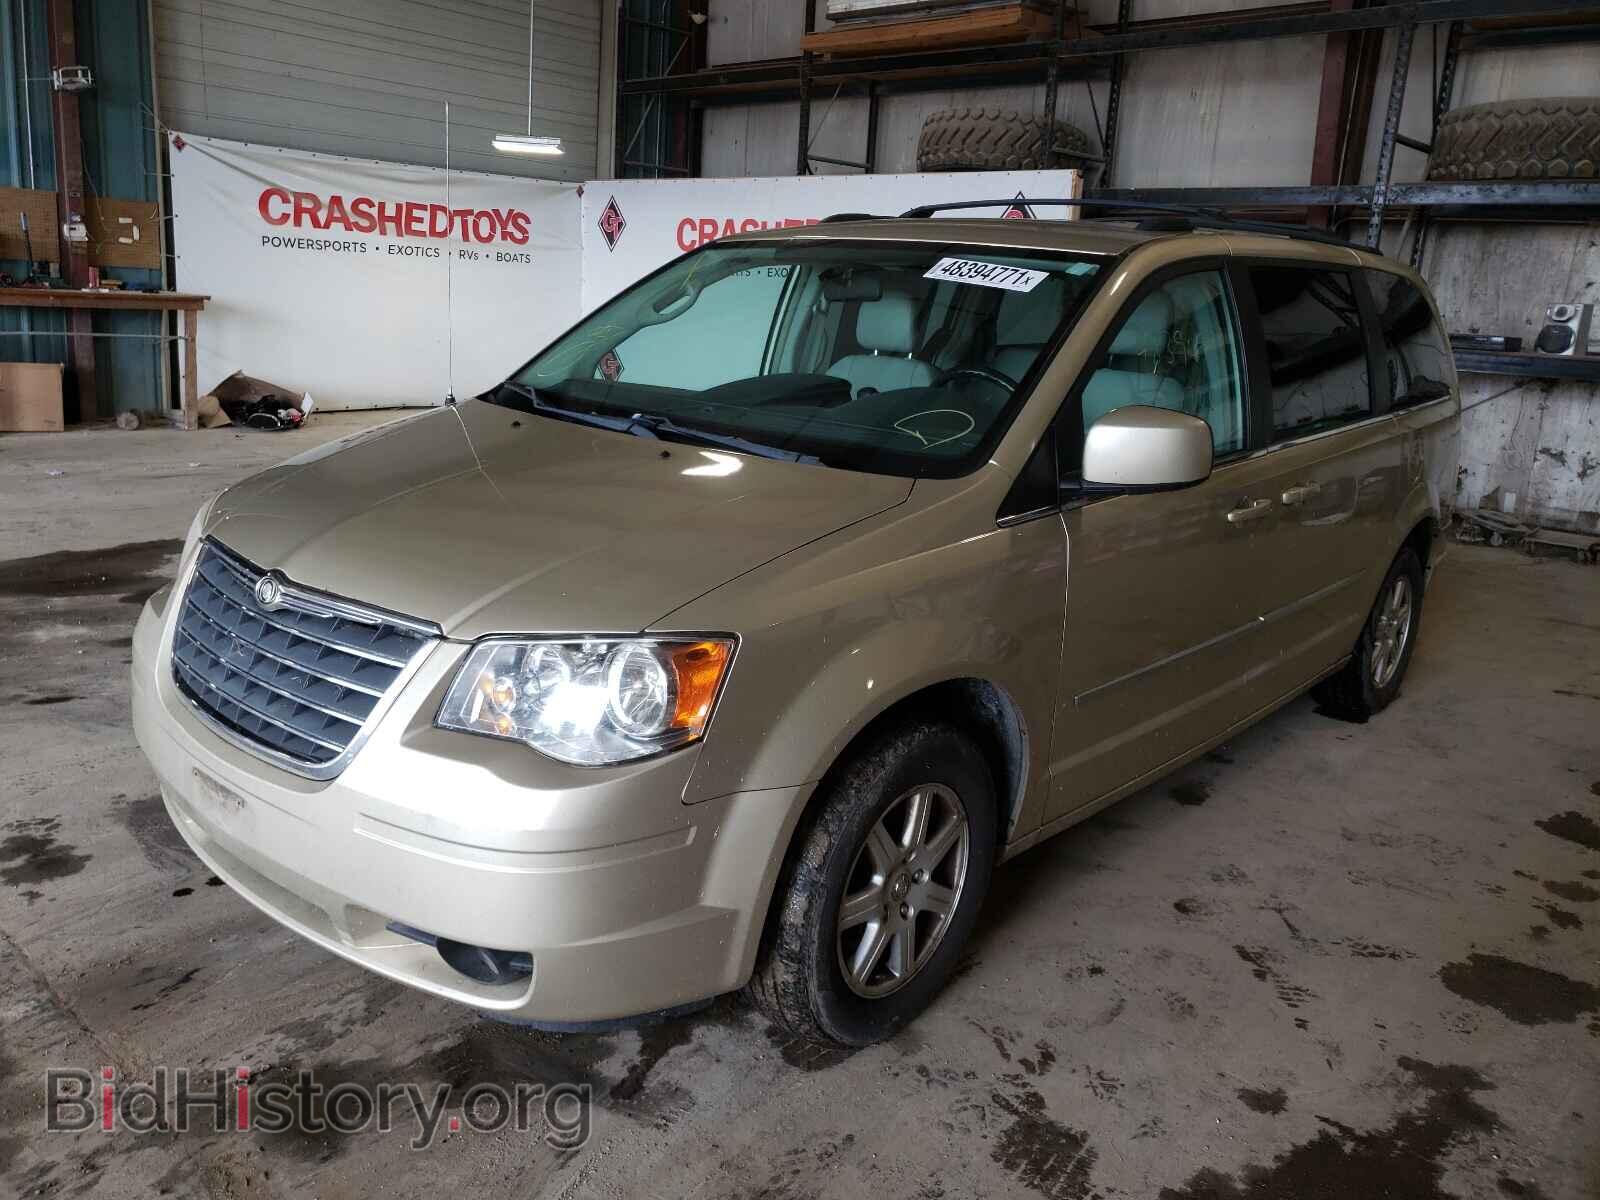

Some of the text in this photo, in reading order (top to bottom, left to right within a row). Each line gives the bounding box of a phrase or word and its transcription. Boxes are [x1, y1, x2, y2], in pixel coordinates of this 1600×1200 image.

[258, 187, 532, 245] CRASHEDTOYS
[261, 235, 531, 264] POWERSPORTS EXOTICS RVs BOATS
[767, 267, 789, 278] EXO
